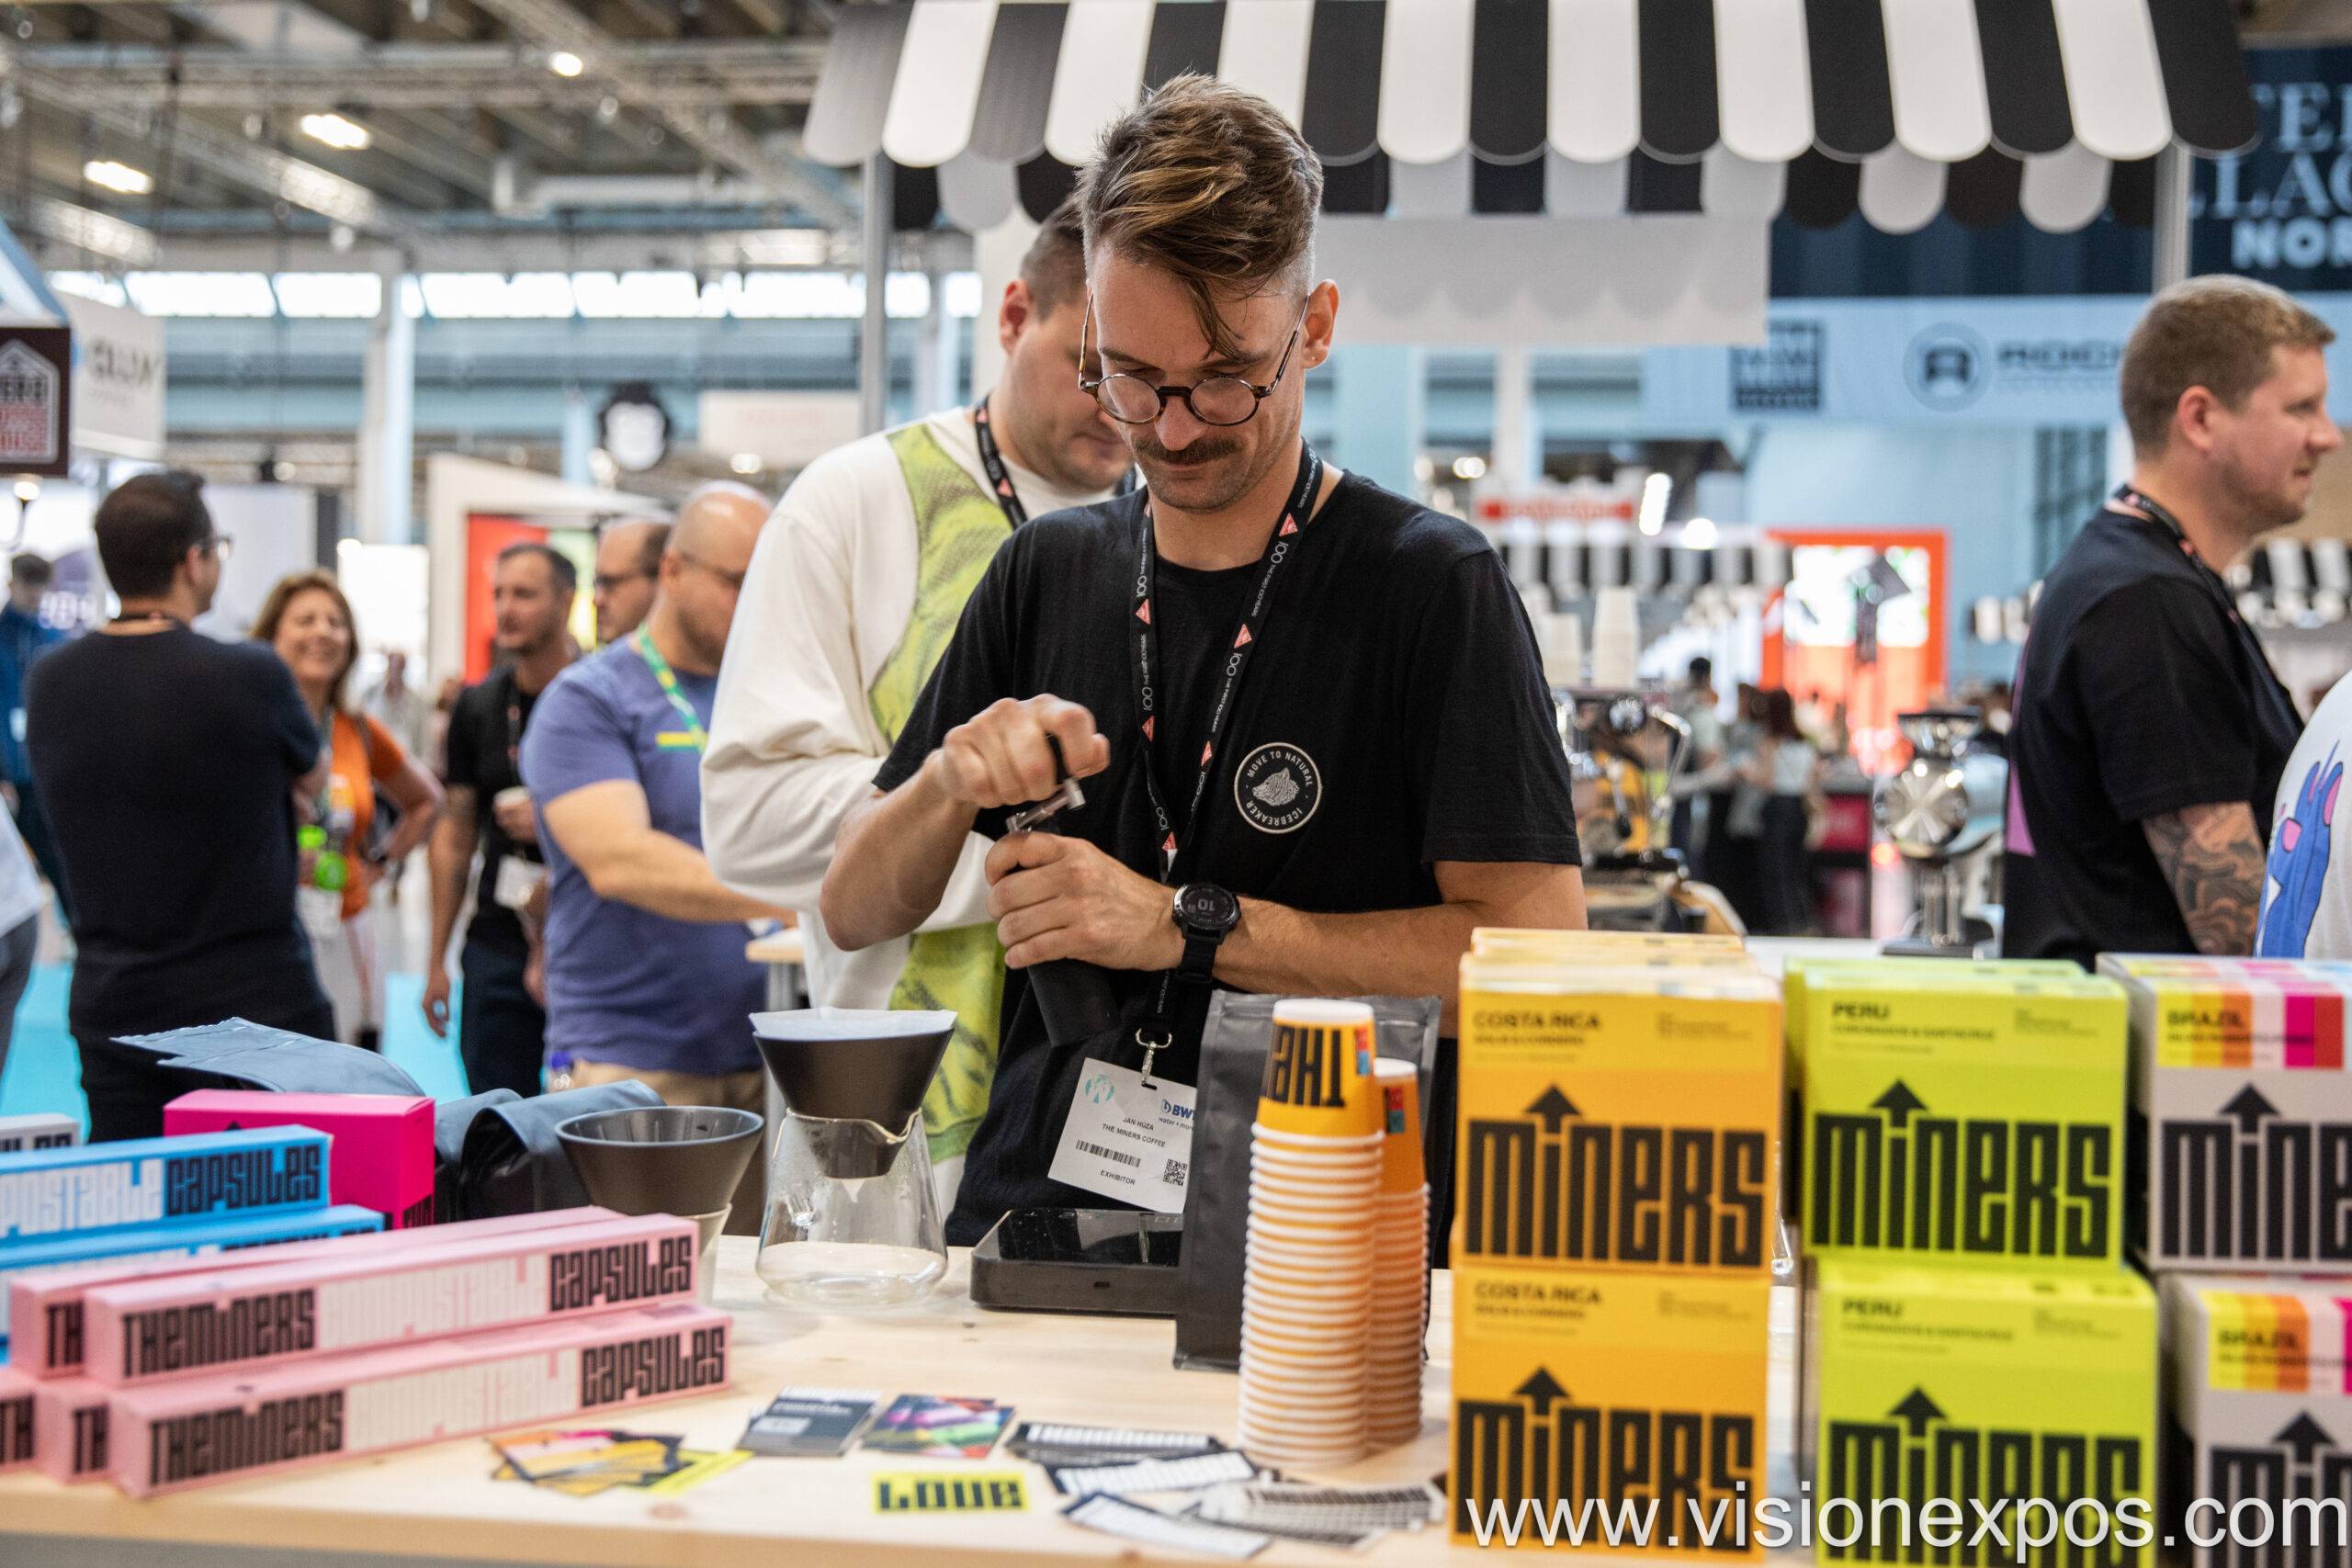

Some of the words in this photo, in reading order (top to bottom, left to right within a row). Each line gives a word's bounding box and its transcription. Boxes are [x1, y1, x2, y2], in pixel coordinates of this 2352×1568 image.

[1271, 541, 1289, 564] 100
[1227, 653, 1242, 676] 100
[1142, 687, 1153, 711] 100
[1247, 754, 1268, 778] MOVE
[1270, 750, 1282, 760] TO
[1285, 752, 1314, 786] NATURAL
[1246, 800, 1303, 826] ICEBREAKER
[1122, 1117, 1135, 1125] JAN
[1136, 1122, 1154, 1131] HUZA
[1159, 1117, 1174, 1125] water
[1102, 1123, 1114, 1133] THE
[1116, 1128, 1141, 1140] MINERS
[1142, 1135, 1166, 1147] COFFEE
[1101, 1169, 1136, 1185] EXHIBITOR
